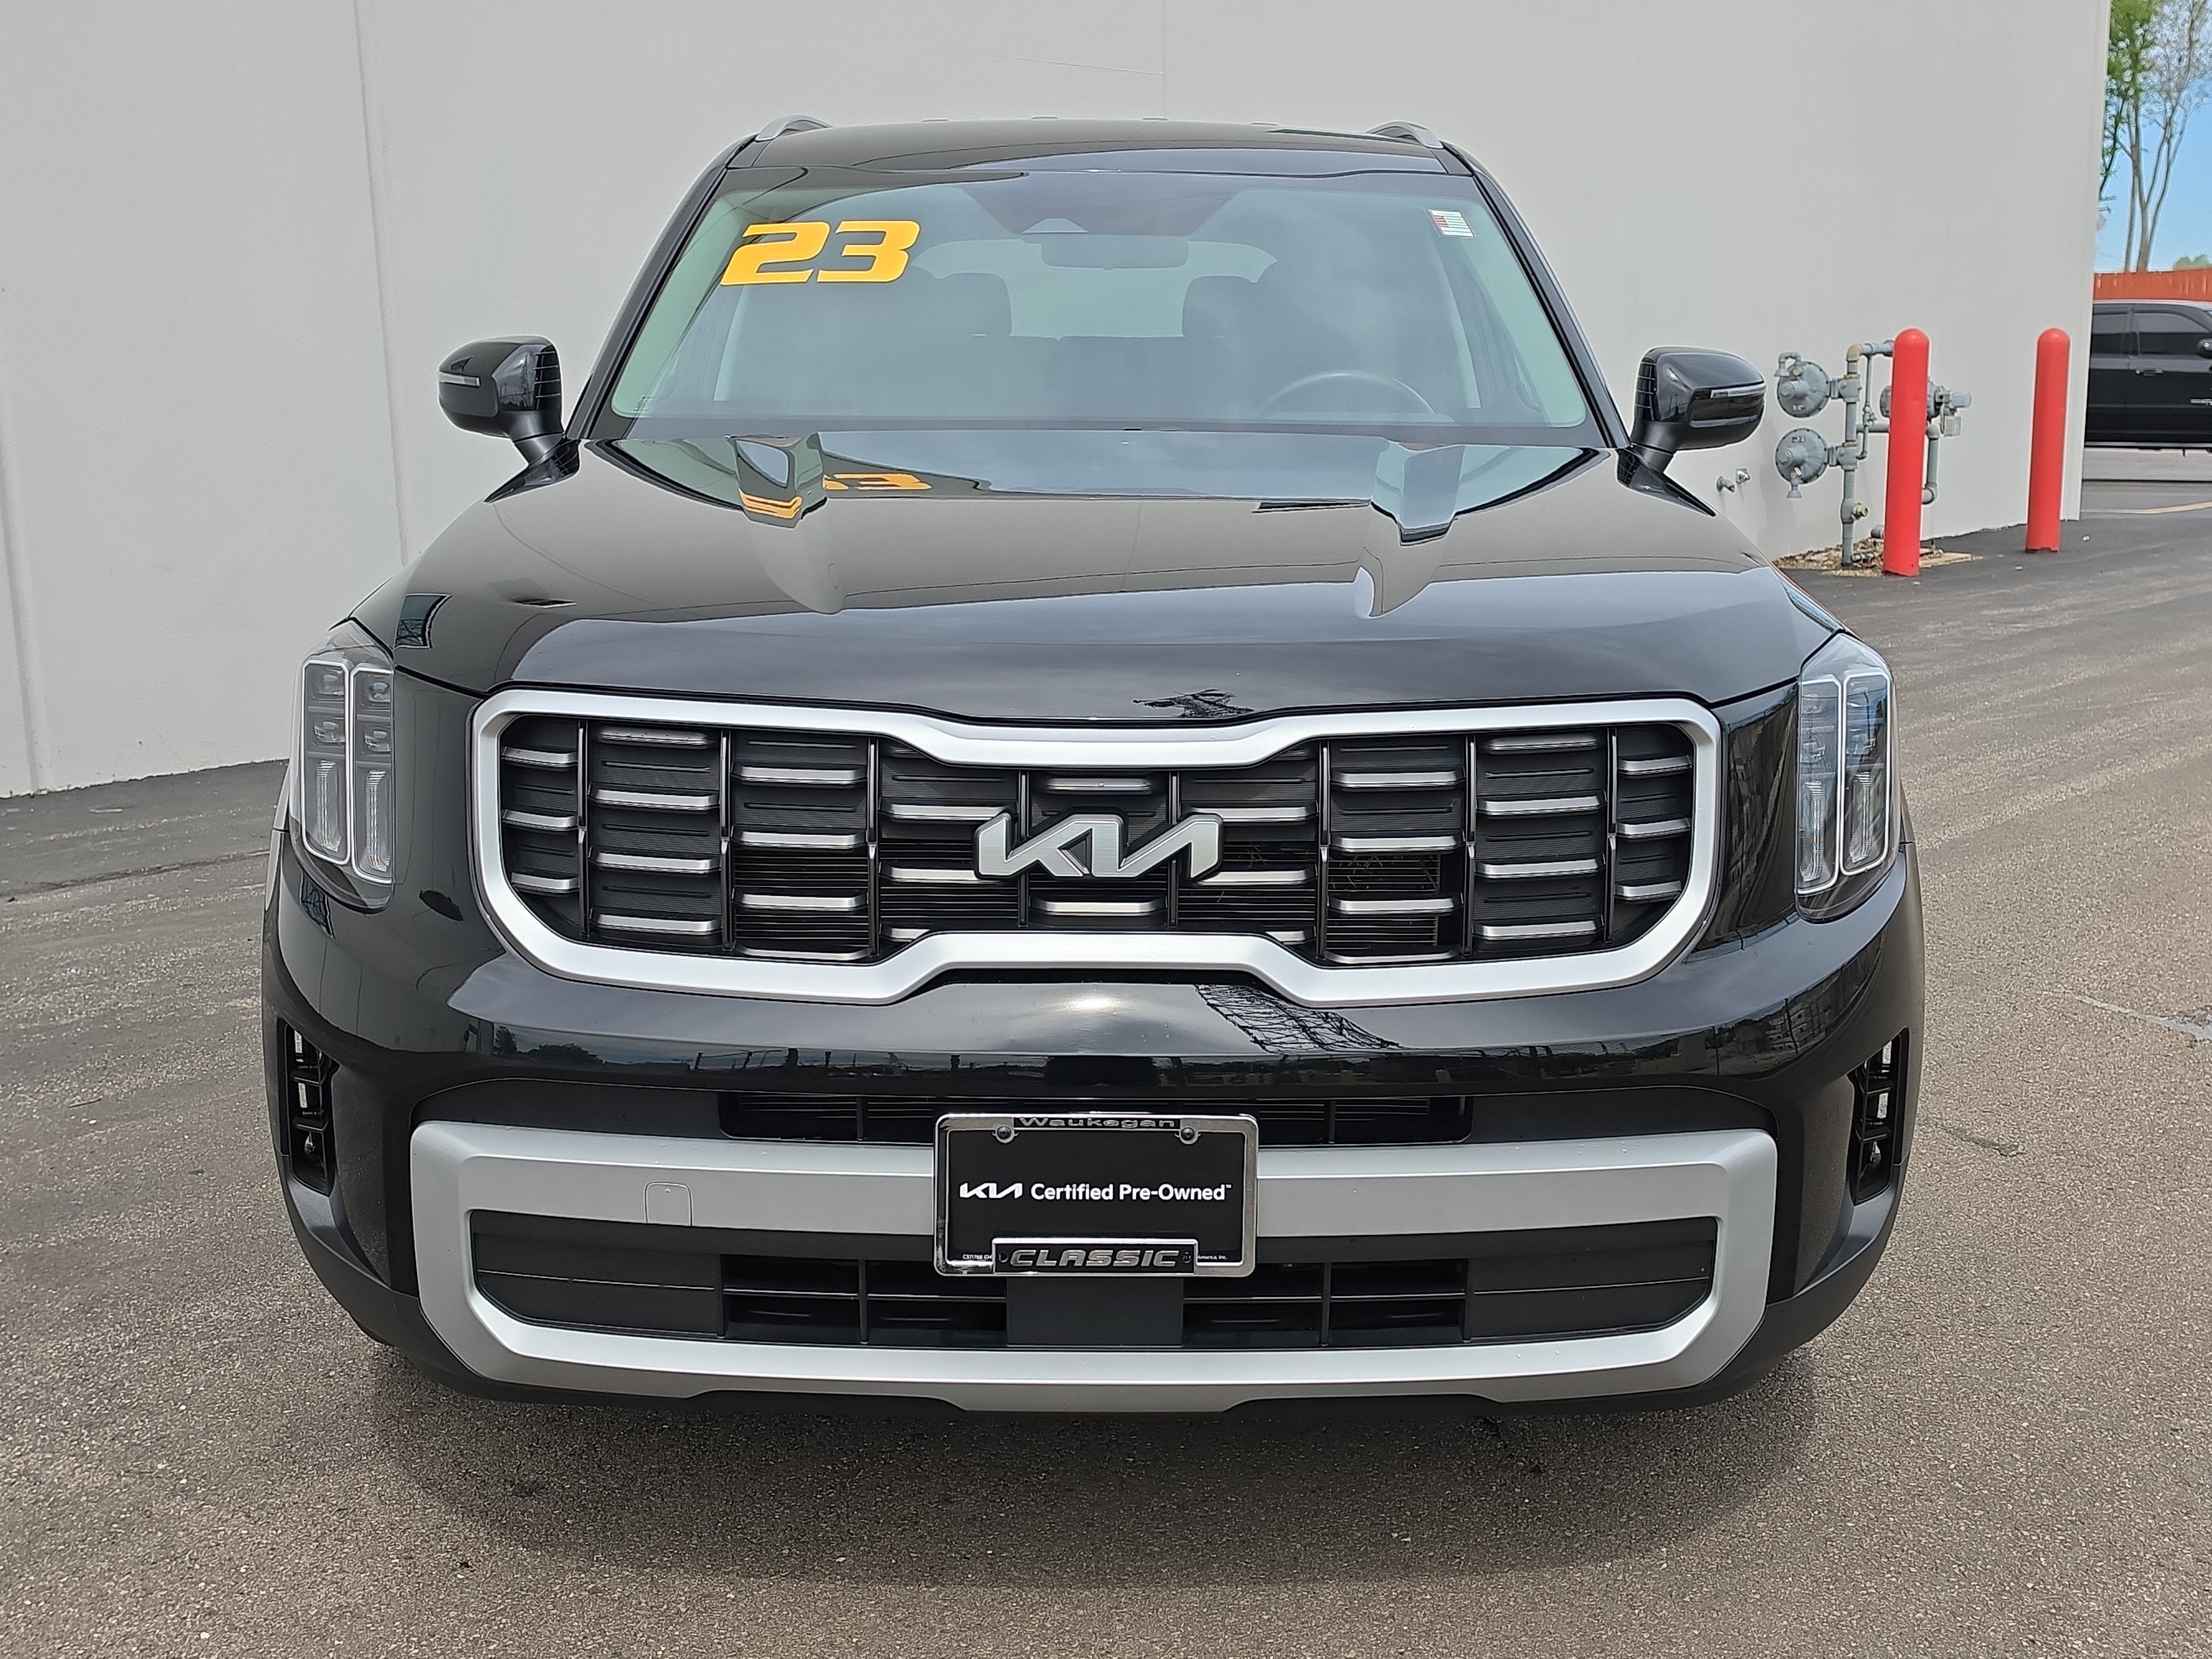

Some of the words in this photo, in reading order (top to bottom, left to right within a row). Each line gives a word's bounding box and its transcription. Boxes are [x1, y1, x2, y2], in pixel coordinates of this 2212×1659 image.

[721, 220, 920, 285] 23
[976, 813, 1223, 879] KIA
[1020, 1117, 1175, 1128] Waukegan
[960, 1182, 1023, 1199] KIA
[1031, 1184, 1113, 1200] Certified
[1010, 1250, 1180, 1267] CLASSIC
